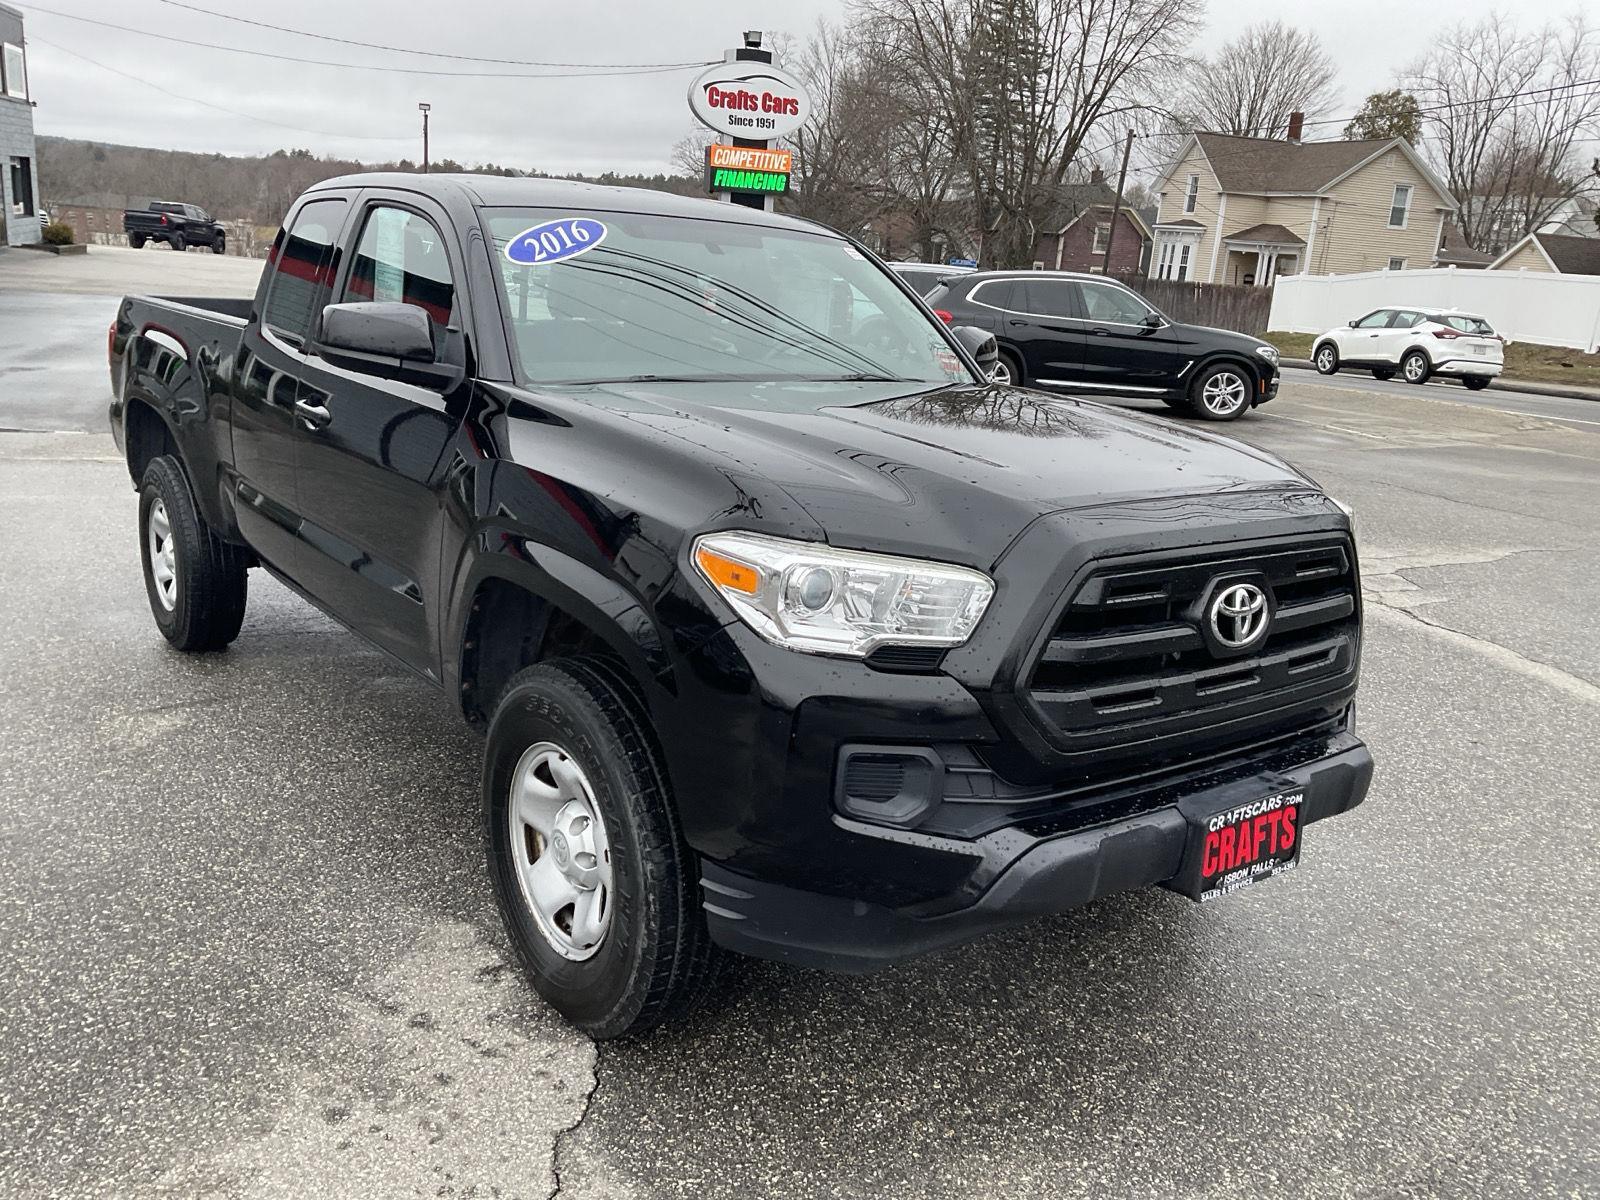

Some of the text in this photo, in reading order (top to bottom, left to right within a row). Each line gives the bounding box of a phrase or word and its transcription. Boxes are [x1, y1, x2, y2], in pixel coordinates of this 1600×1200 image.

[708, 87, 799, 116] Crafts Cars
[728, 115, 776, 130] Since 1951
[714, 150, 788, 169] COMPETITIVE
[714, 170, 786, 191] FINANCING
[524, 221, 590, 262] 2016
[1209, 794, 1303, 832] CRAFTSCARSCOM
[1202, 806, 1297, 878] CRAFTS
[1218, 858, 1275, 886] ISBON FALLS
[1200, 888, 1221, 903] SALES
[1221, 886, 1227, 895] &
[1227, 877, 1254, 893] SERVICE
